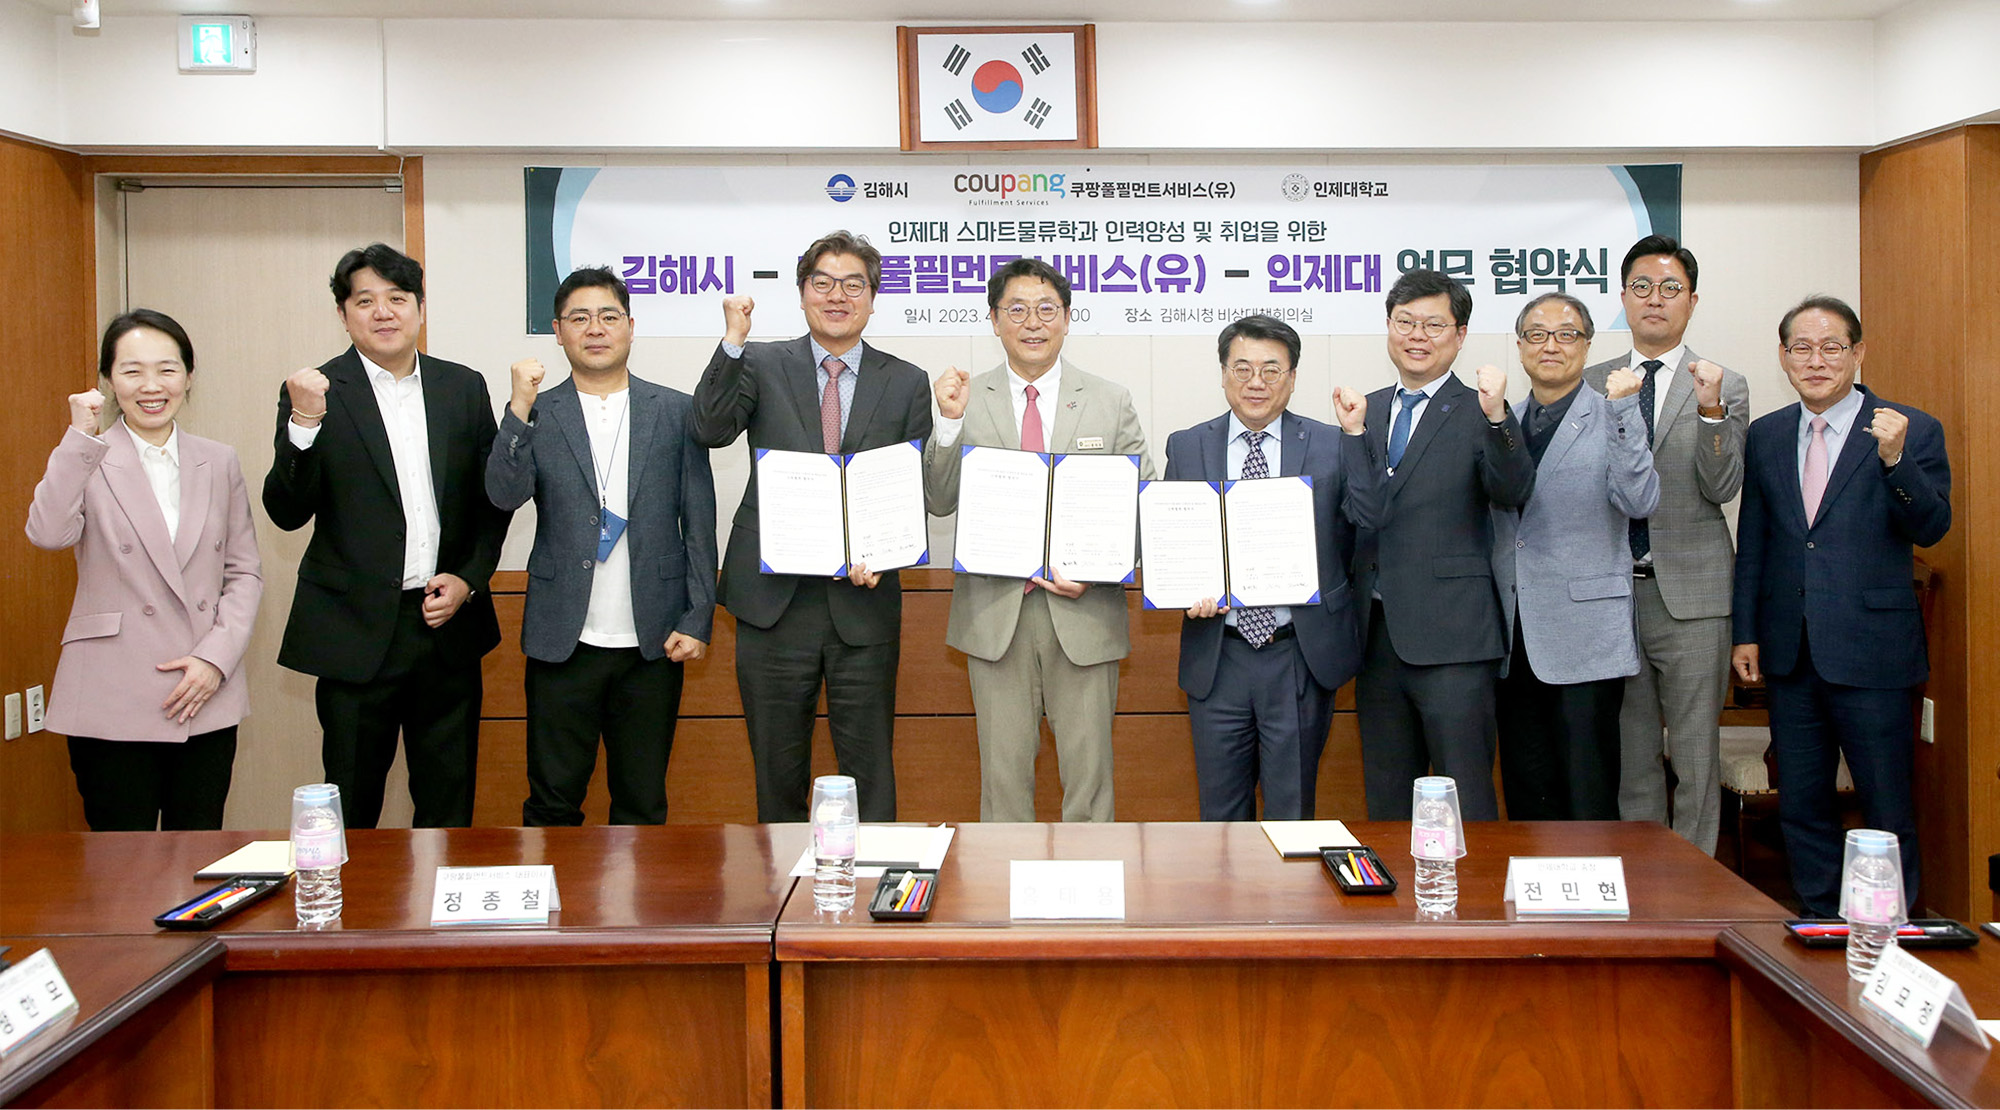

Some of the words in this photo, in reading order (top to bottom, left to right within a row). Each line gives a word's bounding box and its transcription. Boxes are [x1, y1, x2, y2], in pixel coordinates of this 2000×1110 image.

[863, 181, 909, 199] 김해시
[953, 173, 1067, 199] coupang
[1070, 181, 1236, 199] 쿠팡풀필먼트서비스(유)
[1313, 181, 1389, 198] 인제대학교
[889, 220, 949, 243] 인제대
[956, 220, 1099, 243] 스마트물류학과
[1105, 220, 1186, 243] 인력양성
[1192, 220, 1212, 243] 및
[1219, 220, 1280, 243] 취업을
[1287, 220, 1328, 243] 위한
[621, 254, 735, 294] 김해시
[1267, 254, 1381, 294] 인제대
[1489, 247, 1608, 294] 협약식
[904, 308, 931, 324] 일시
[938, 308, 982, 323] 2023.
[1124, 308, 1153, 323] 장소
[1160, 308, 1213, 323] 김해시청
